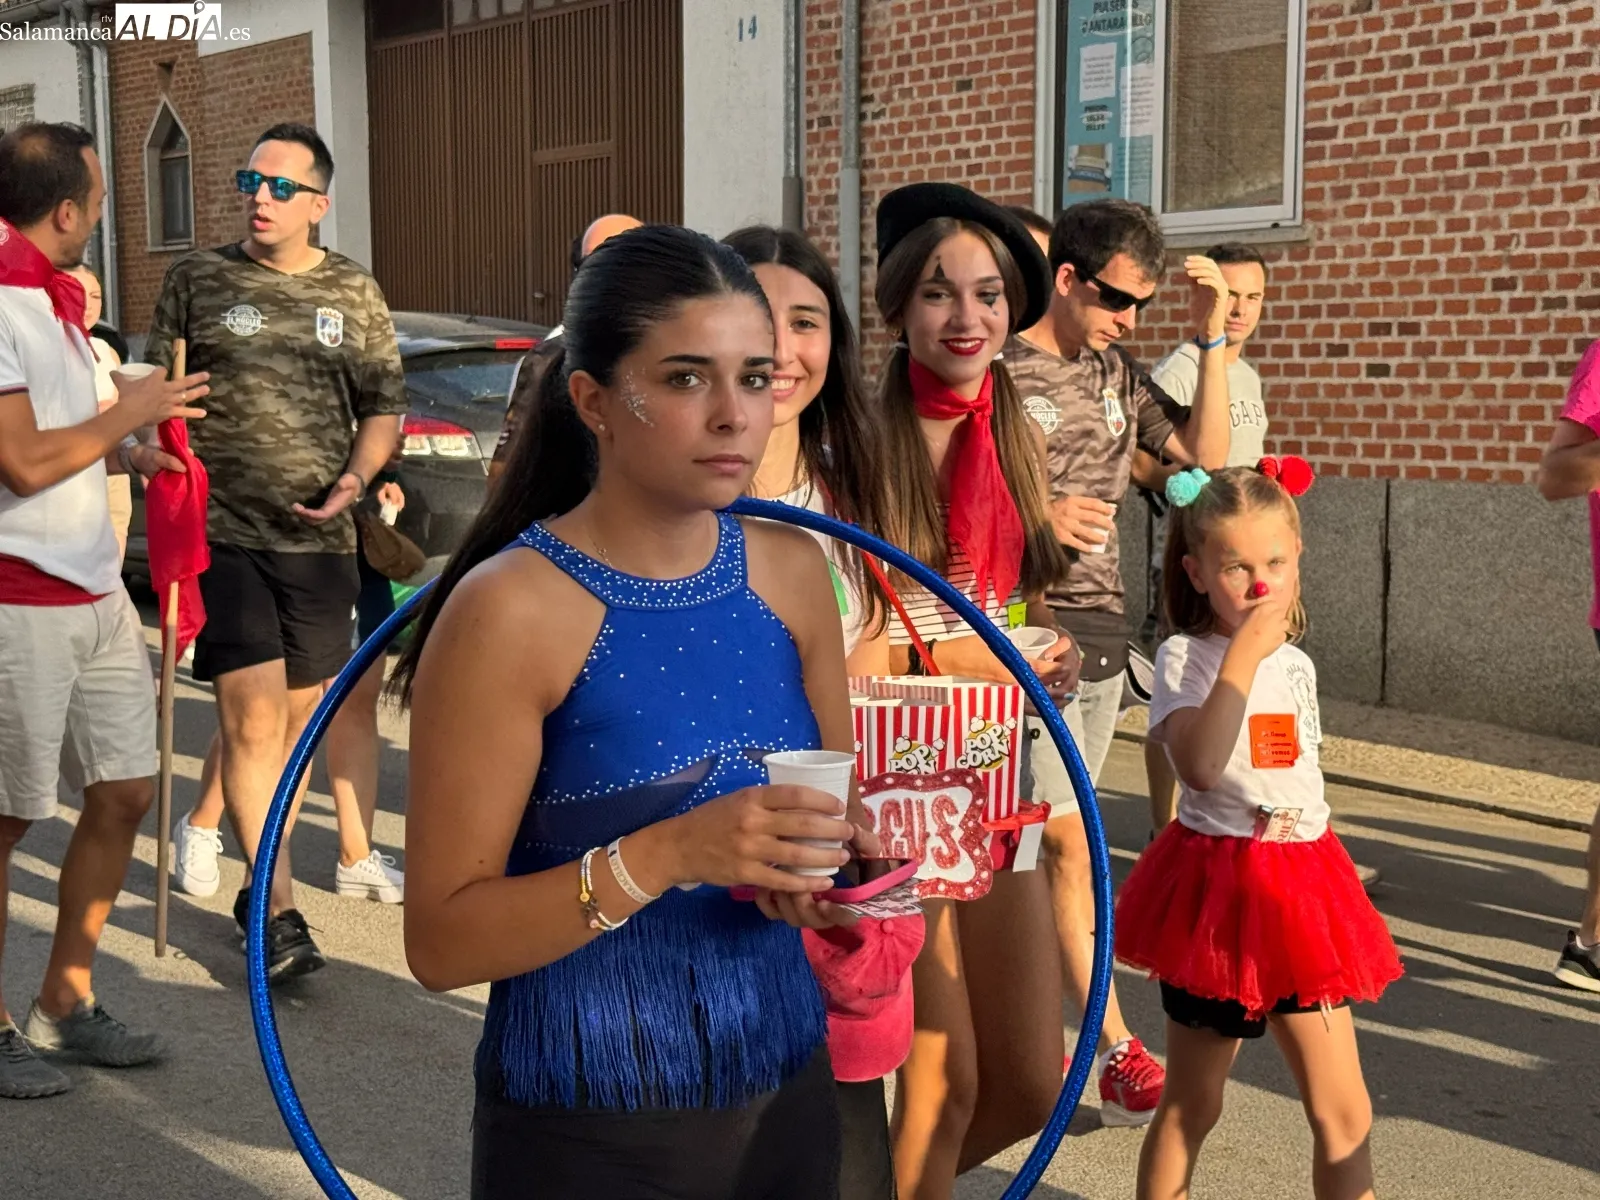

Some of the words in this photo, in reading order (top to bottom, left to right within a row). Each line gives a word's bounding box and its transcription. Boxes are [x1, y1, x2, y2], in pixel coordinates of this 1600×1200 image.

[738, 14, 757, 42] 14
[1229, 400, 1262, 428] GAP
[964, 724, 1003, 753] POP
[889, 744, 931, 773] POP
[956, 738, 1010, 769] CORN
